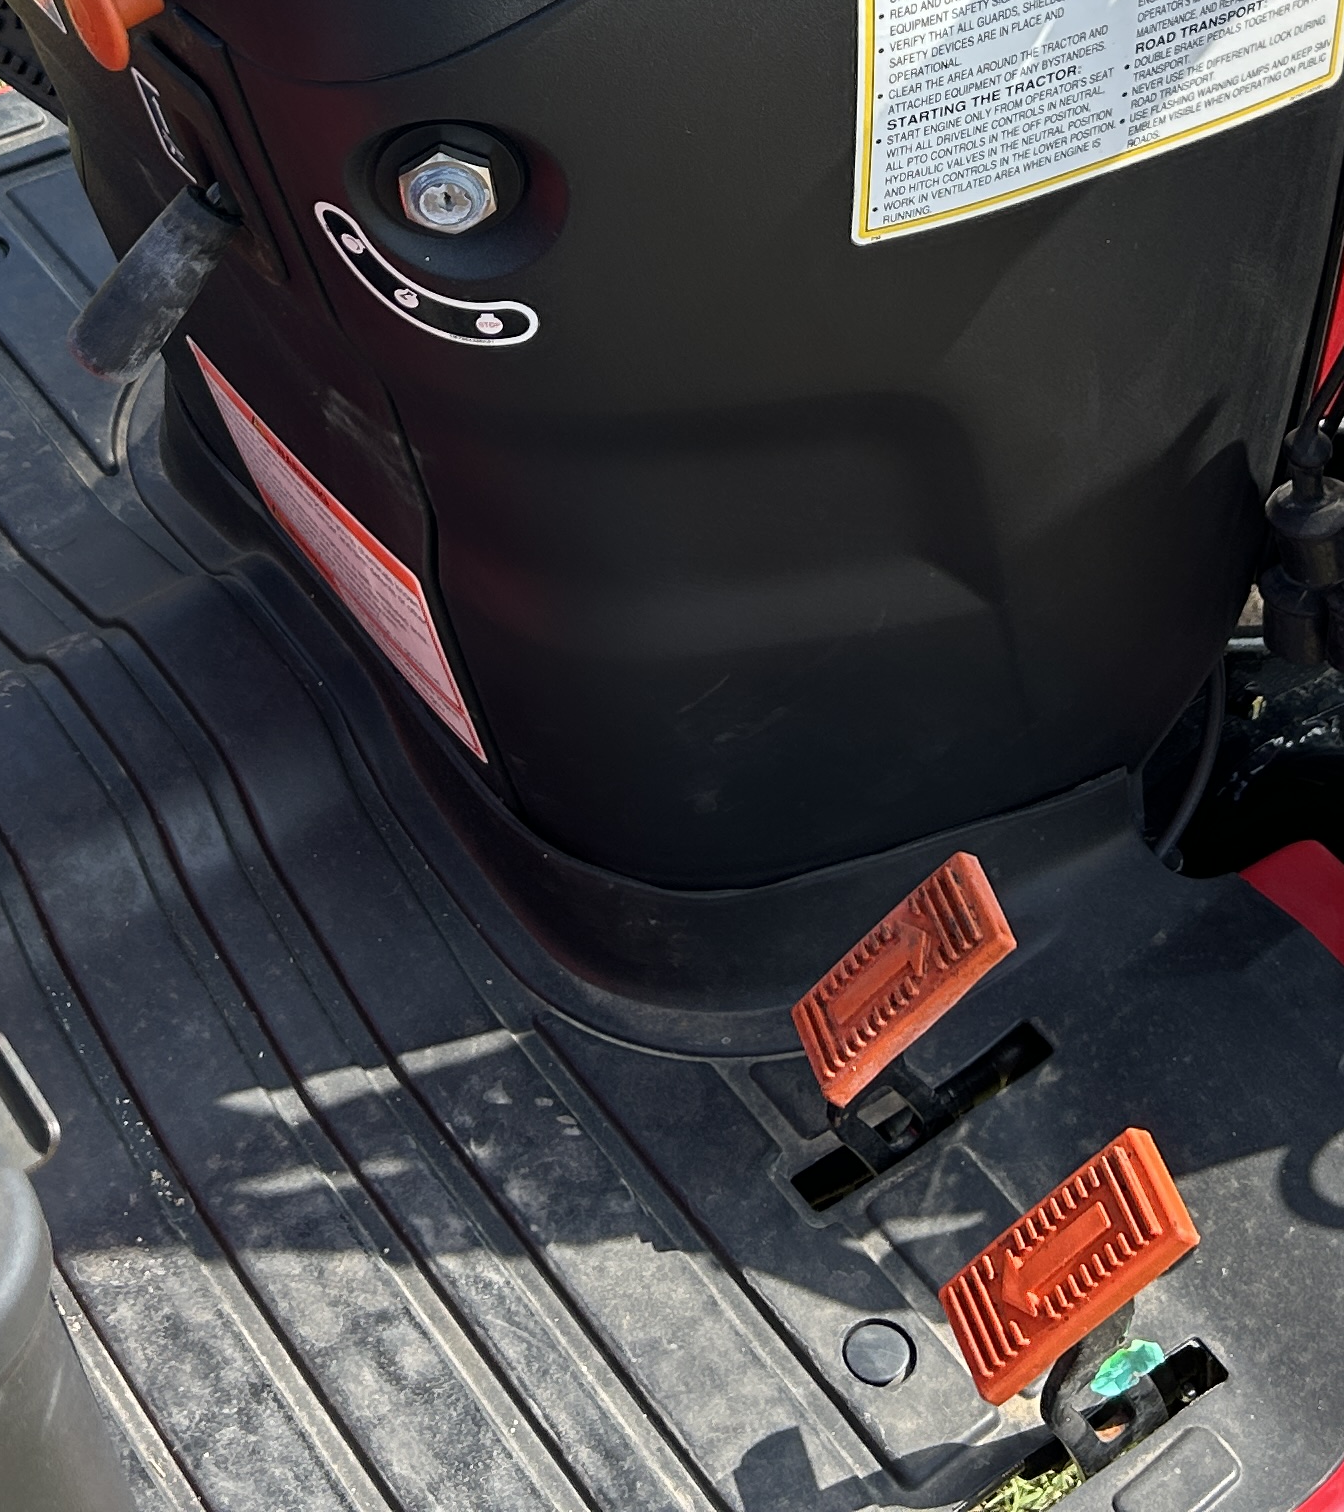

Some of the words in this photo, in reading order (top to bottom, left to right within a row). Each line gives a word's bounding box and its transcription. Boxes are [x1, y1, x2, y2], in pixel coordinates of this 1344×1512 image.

[889, 32, 925, 53] VERIFY
[928, 24, 954, 41] THAT
[957, 17, 974, 32] ALL
[889, 48, 927, 70] SAFETY
[931, 34, 974, 57] DEVICES
[977, 27, 996, 43] ARE
[1000, 24, 1008, 36] IN
[1011, 13, 1041, 32] PLACE
[1044, 7, 1064, 22] AND
[890, 3, 917, 21] READ
[890, 10, 948, 37] EQUIPMENT
[1134, 47, 1171, 68] DOUBLE
[1174, 35, 1204, 54] BRAKE
[1206, 22, 1241, 43] PEDALS
[1243, 3, 1290, 30] TOGETHER
[1135, 30, 1175, 54] ROAD
[887, 90, 941, 116] ATTACHED
[944, 72, 1000, 99] EQUIPMENT
[1004, 67, 1017, 81] OF
[1020, 61, 1038, 76] ANY
[888, 81, 921, 101] CLEAR
[925, 74, 944, 89] THE
[947, 65, 973, 83] AREA
[976, 52, 1017, 74] AROUND
[1020, 45, 1039, 60] THE
[1041, 31, 1085, 54] TRACTOR
[1088, 24, 1108, 39] AND
[886, 127, 920, 146] START
[923, 115, 961, 135] ENGINE
[964, 106, 991, 124] ONLY
[994, 96, 1022, 114] FROM
[1089, 67, 1114, 84] SEAT
[887, 98, 965, 132] STARTING
[972, 87, 1000, 106] THE
[1005, 63, 1082, 96] TRACTOR:
[1131, 92, 1156, 109] ROAD
[884, 161, 943, 187] HYDRAULIC
[946, 149, 985, 169] VALVES
[988, 145, 997, 158] IN
[999, 138, 1019, 154] THE
[1021, 123, 1065, 147] NEUTRAL
[1068, 108, 1112, 131] POSITION
[885, 159, 903, 173] ALL
[906, 152, 927, 167] PTO
[930, 136, 985, 160] CONTROLS
[989, 132, 998, 144] IN
[1001, 124, 1019, 140] THE
[1022, 118, 1041, 133] OFF
[886, 143, 912, 160] WITH
[915, 138, 933, 152] ALL
[936, 122, 988, 145] DRIVELINE
[991, 103, 1044, 130] CONTROLS
[1047, 99, 1056, 112] IN
[883, 196, 915, 214] WORK
[918, 192, 928, 204] IN
[931, 174, 991, 200] VENTILATED
[994, 164, 1020, 182] AREA
[1023, 154, 1051, 172] WHEN
[1054, 141, 1089, 162] ENGINE
[1091, 138, 1101, 149] IS
[884, 185, 905, 201] AND
[908, 176, 939, 193] HITCH
[942, 159, 997, 184] CONTROLS
[1000, 155, 1009, 166] IN
[1012, 147, 1031, 162] THE
[1033, 135, 1067, 156] LOWER
[478, 320, 501, 329] STOP
